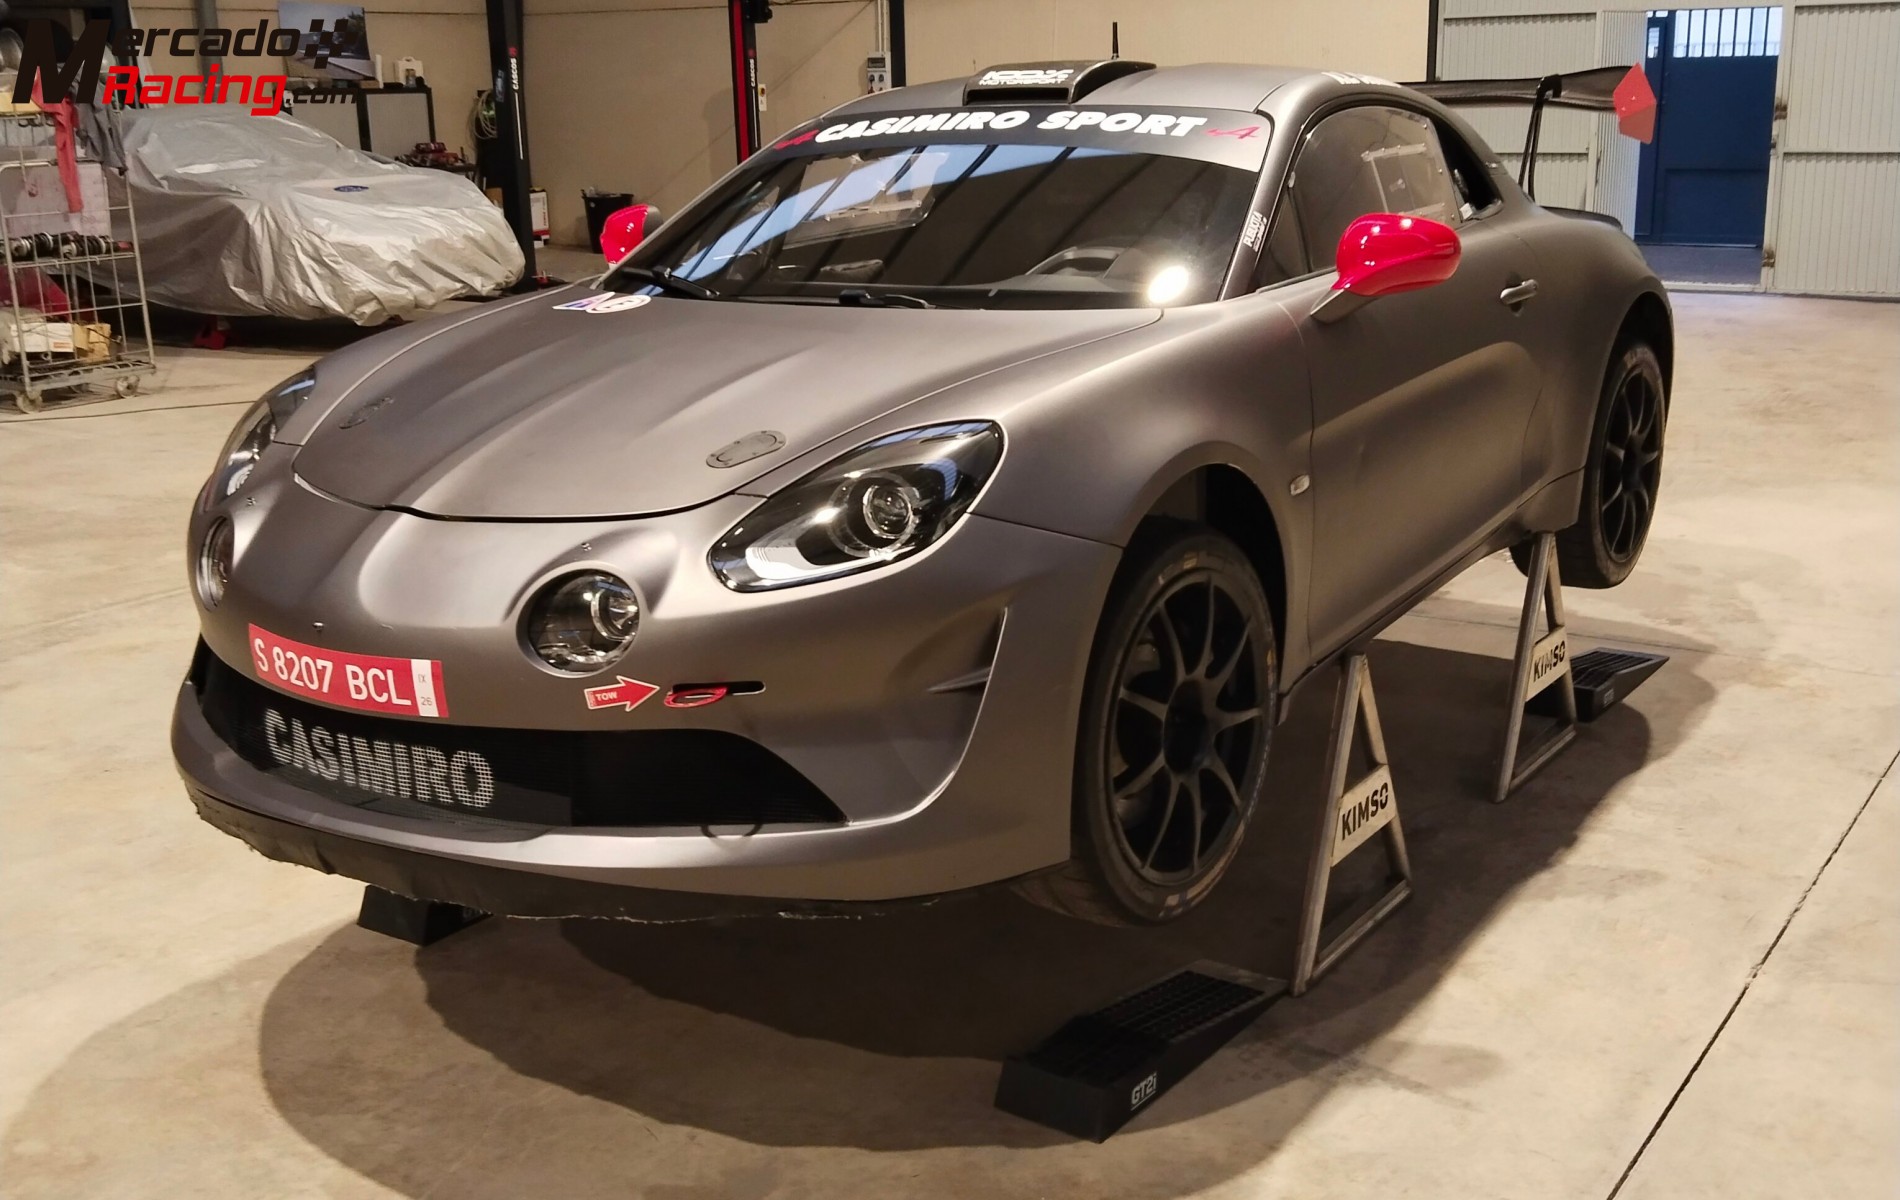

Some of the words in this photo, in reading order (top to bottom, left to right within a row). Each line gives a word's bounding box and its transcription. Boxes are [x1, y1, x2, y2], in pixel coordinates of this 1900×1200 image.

[510, 58, 519, 90] CASCOS
[979, 78, 1066, 86] MOTORSPORT
[815, 110, 1030, 143] CASIMIRO
[1037, 110, 1208, 136] SPORT
[254, 638, 269, 672] S
[272, 646, 334, 694] 8207
[345, 664, 412, 706] BCL
[1533, 640, 1566, 683] KIMSO
[420, 697, 433, 706] 26
[595, 691, 618, 702] TOW
[265, 708, 495, 808] CASIMIRO
[1342, 782, 1389, 841] KIMSO
